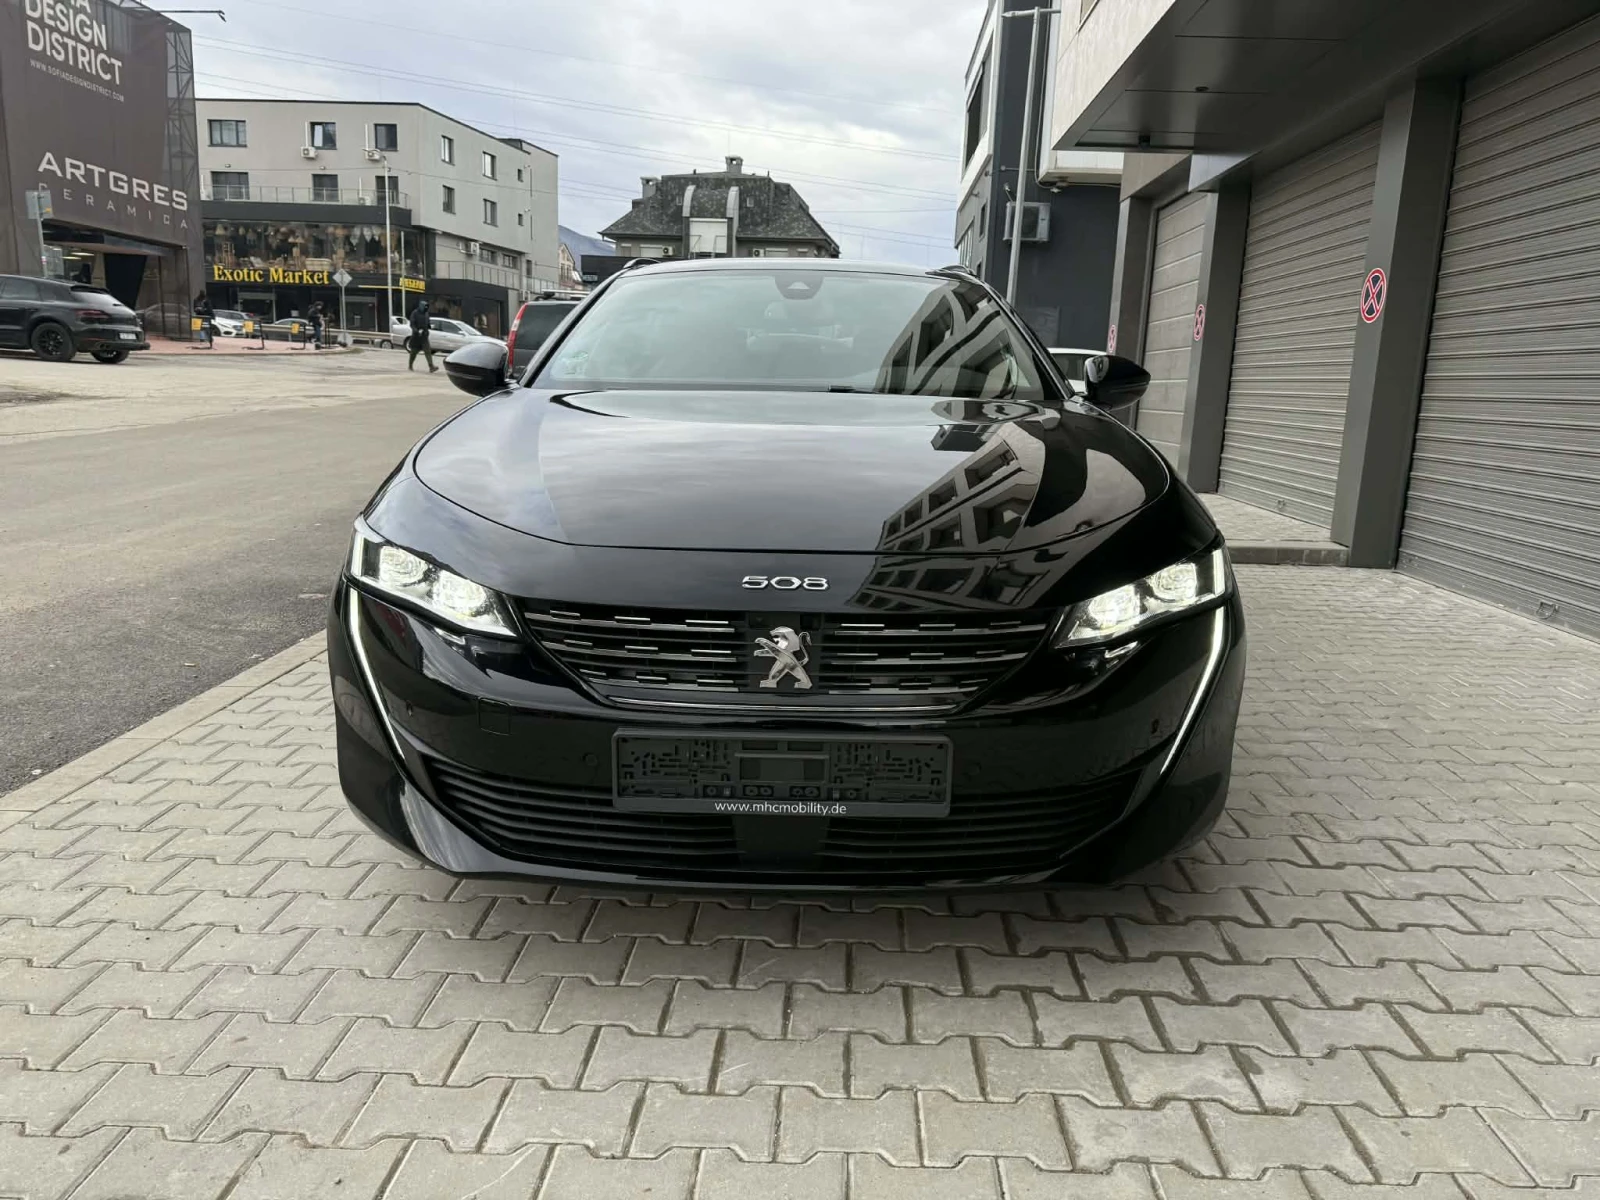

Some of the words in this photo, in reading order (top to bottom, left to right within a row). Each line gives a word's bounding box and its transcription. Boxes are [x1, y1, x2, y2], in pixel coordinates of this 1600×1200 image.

[25, 0, 107, 51] DESIGN
[26, 20, 122, 86] DISTRICT
[38, 152, 188, 211] ARTGRES
[213, 264, 264, 281] Exotic
[269, 266, 330, 285] Market
[742, 575, 829, 591] 508
[714, 801, 847, 816] www.mhcmobility.de
